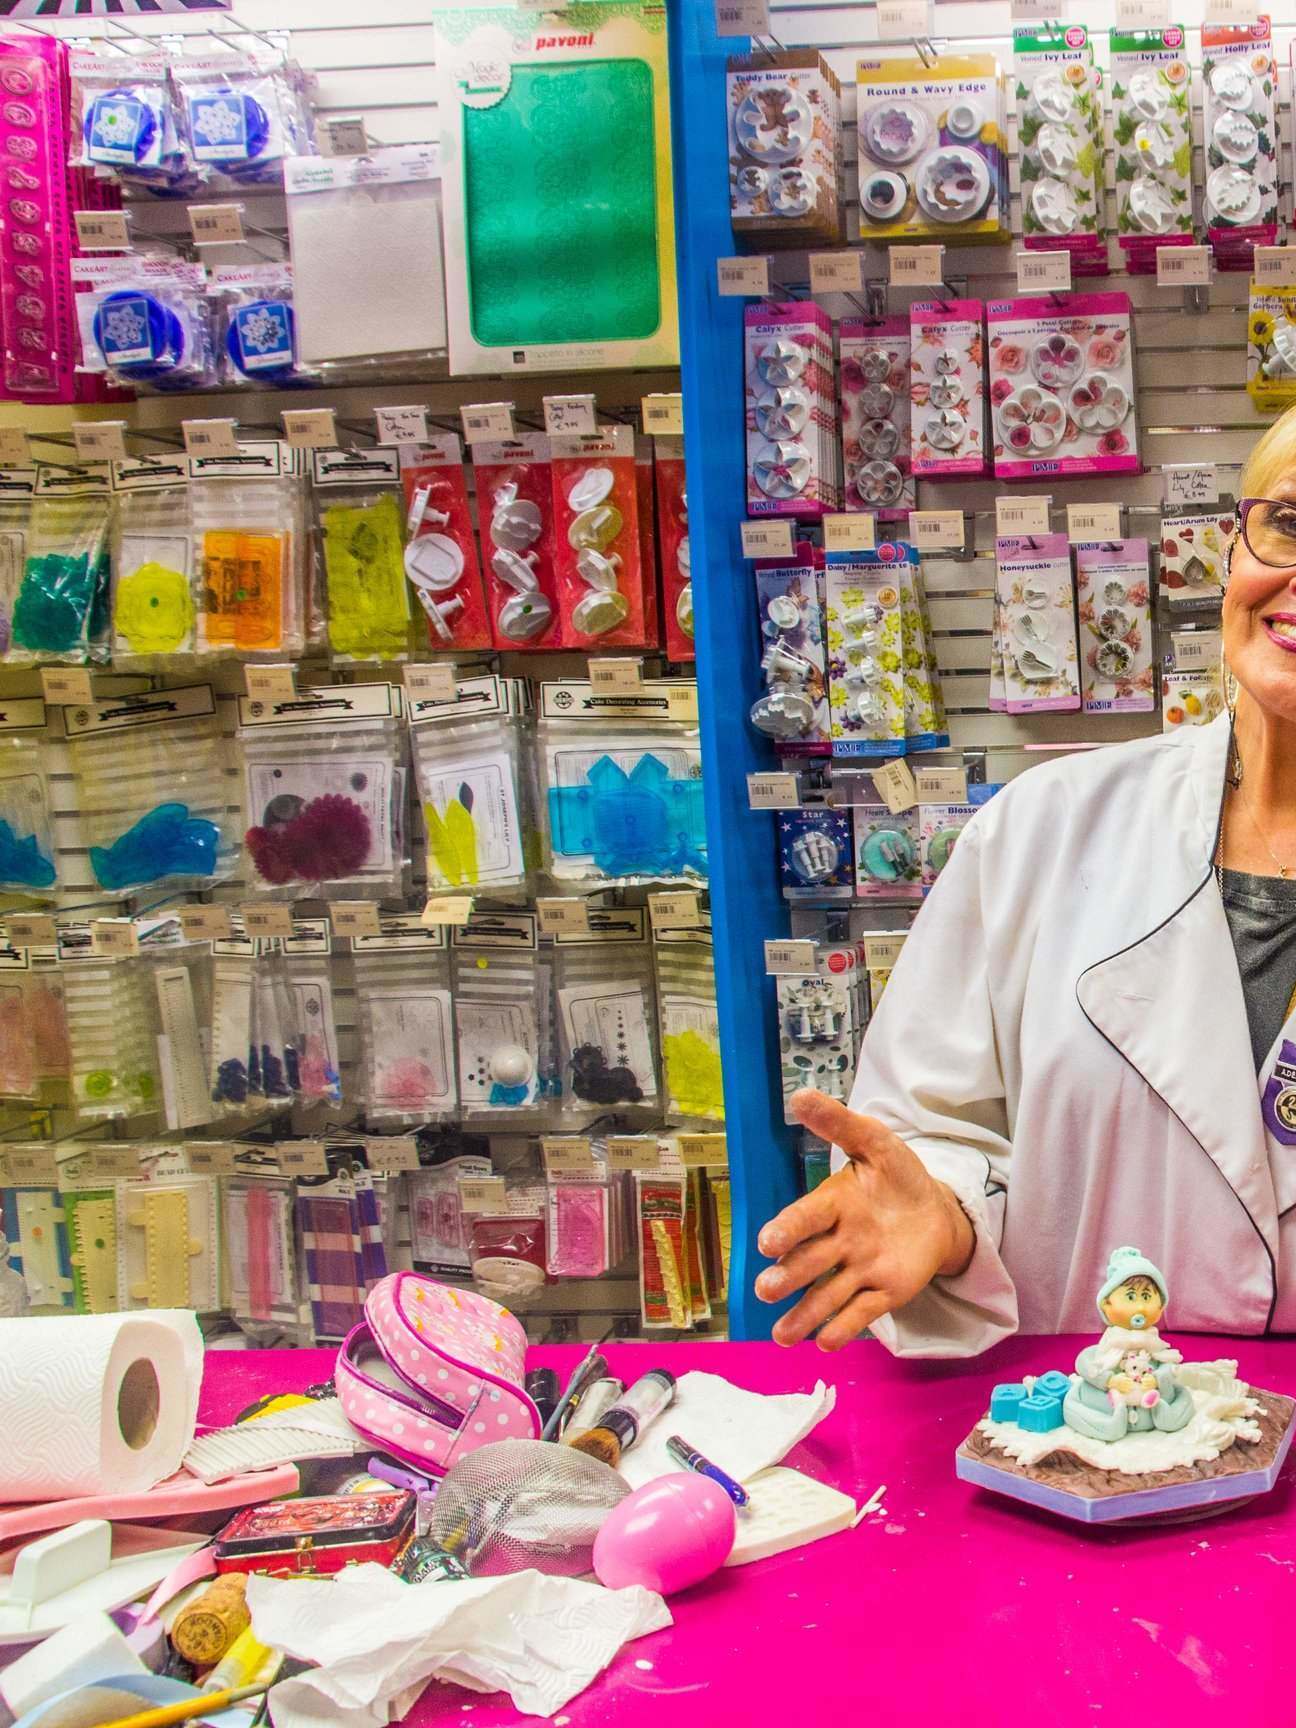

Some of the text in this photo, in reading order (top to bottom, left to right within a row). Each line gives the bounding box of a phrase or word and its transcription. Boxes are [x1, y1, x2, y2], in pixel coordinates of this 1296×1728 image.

[535, 33, 594, 50] pavoni
[1225, 44, 1250, 54] Holly
[1251, 42, 1271, 51] Leaf
[1044, 53, 1059, 62] Ivy
[1062, 52, 1082, 60] Leaf
[1141, 53, 1155, 62] Ivy
[1159, 52, 1179, 60] Leaf
[765, 72, 787, 81] Bear
[866, 83, 987, 97] Round & Wavy Edge
[755, 326, 781, 335] Calyx
[776, 567, 812, 578] Butterfly
[827, 564, 847, 572] Daisy
[852, 563, 897, 571] Marguerite
[1000, 563, 1051, 572] Honeysuckle
[886, 808, 913, 818] Spe
[947, 806, 979, 815] Blosso
